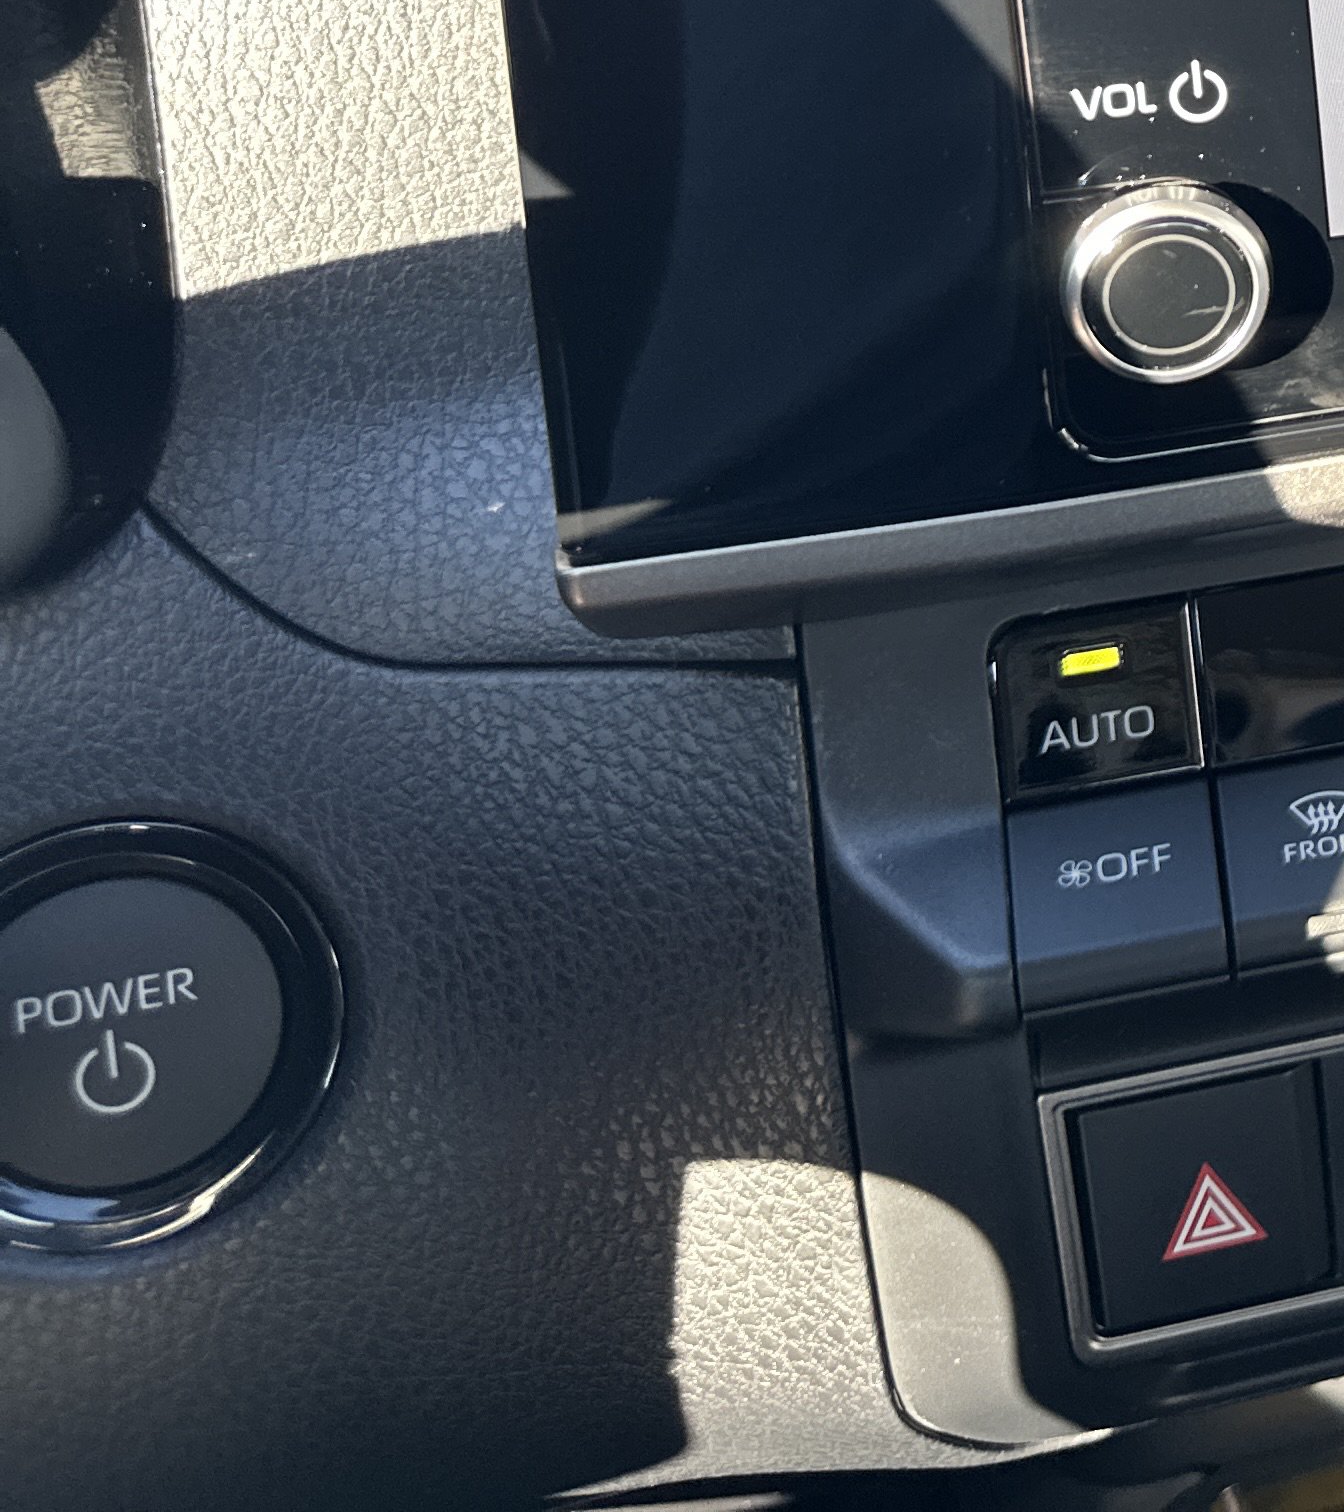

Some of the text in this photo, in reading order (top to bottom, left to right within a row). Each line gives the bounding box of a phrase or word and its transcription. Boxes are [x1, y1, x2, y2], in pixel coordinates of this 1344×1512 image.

[1069, 80, 1158, 121] VOL
[1040, 704, 1156, 756] AUTO
[1096, 843, 1173, 884] OFF
[14, 966, 199, 1035] POWER
